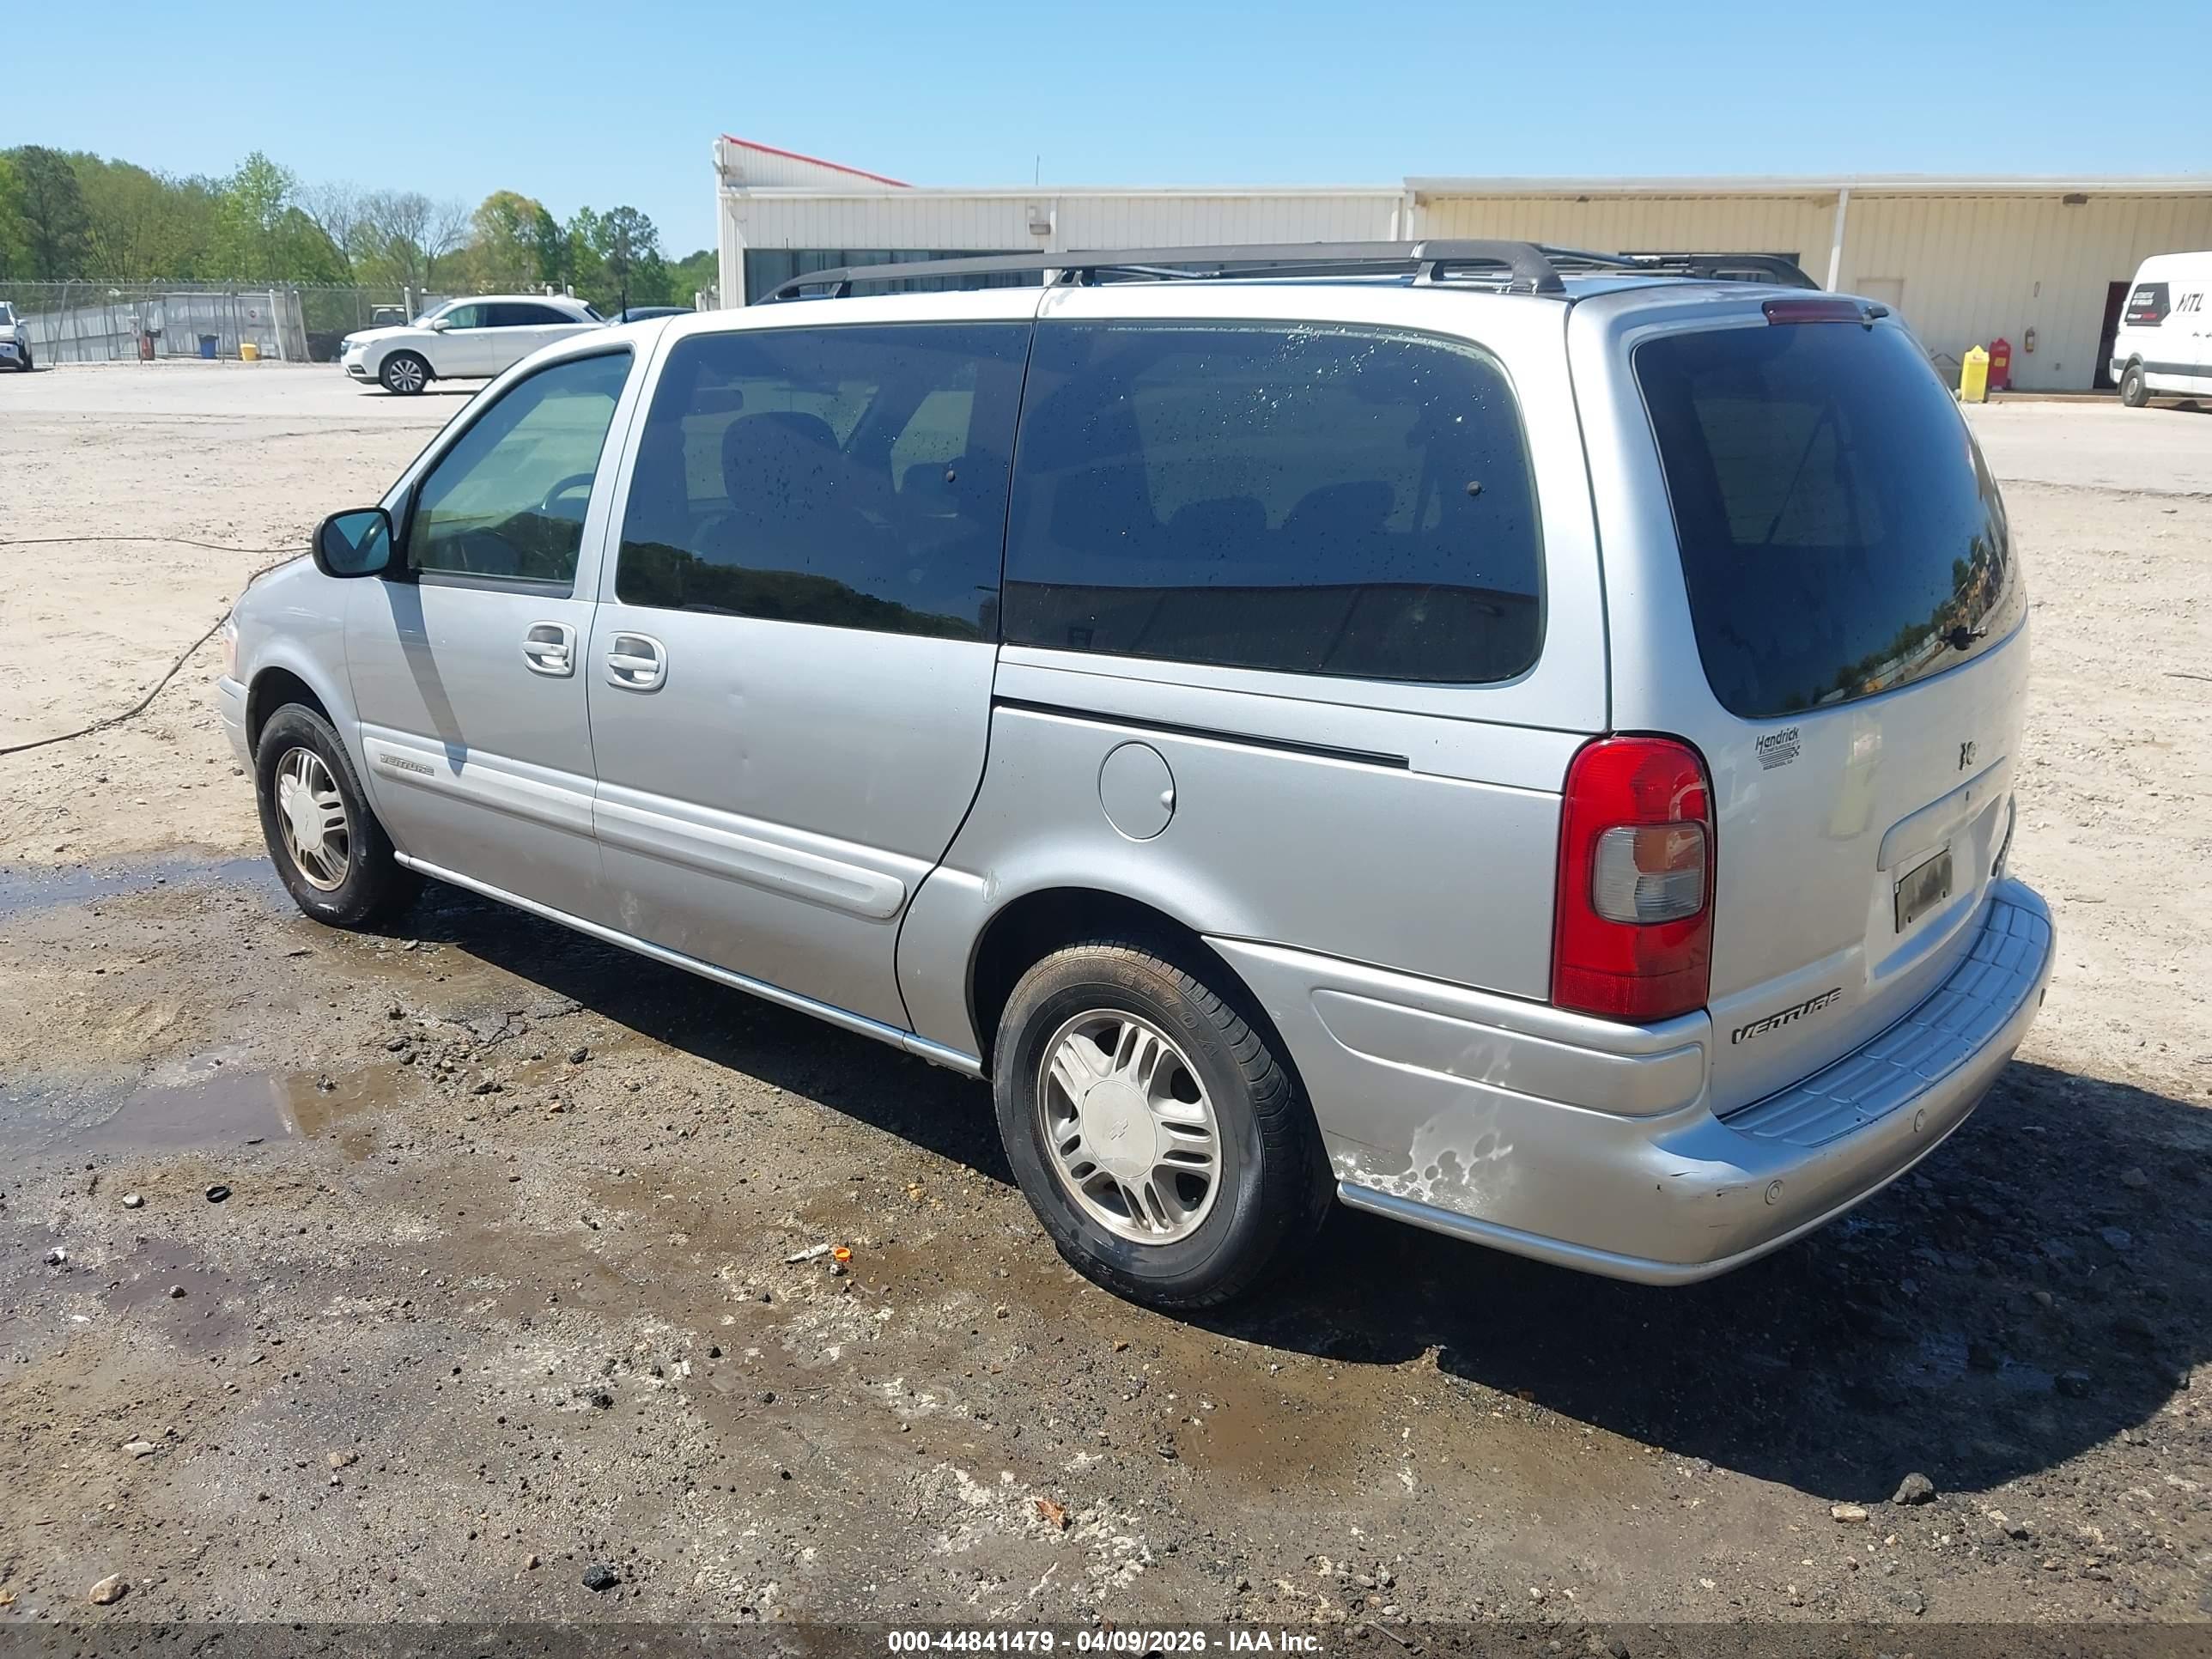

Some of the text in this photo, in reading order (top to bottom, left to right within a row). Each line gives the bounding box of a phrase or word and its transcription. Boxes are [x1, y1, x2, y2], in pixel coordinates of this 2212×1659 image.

[1754, 726, 1800, 756] Hendrick
[380, 753, 435, 777] VENTURE
[1731, 987, 1843, 1045] VENTURE
